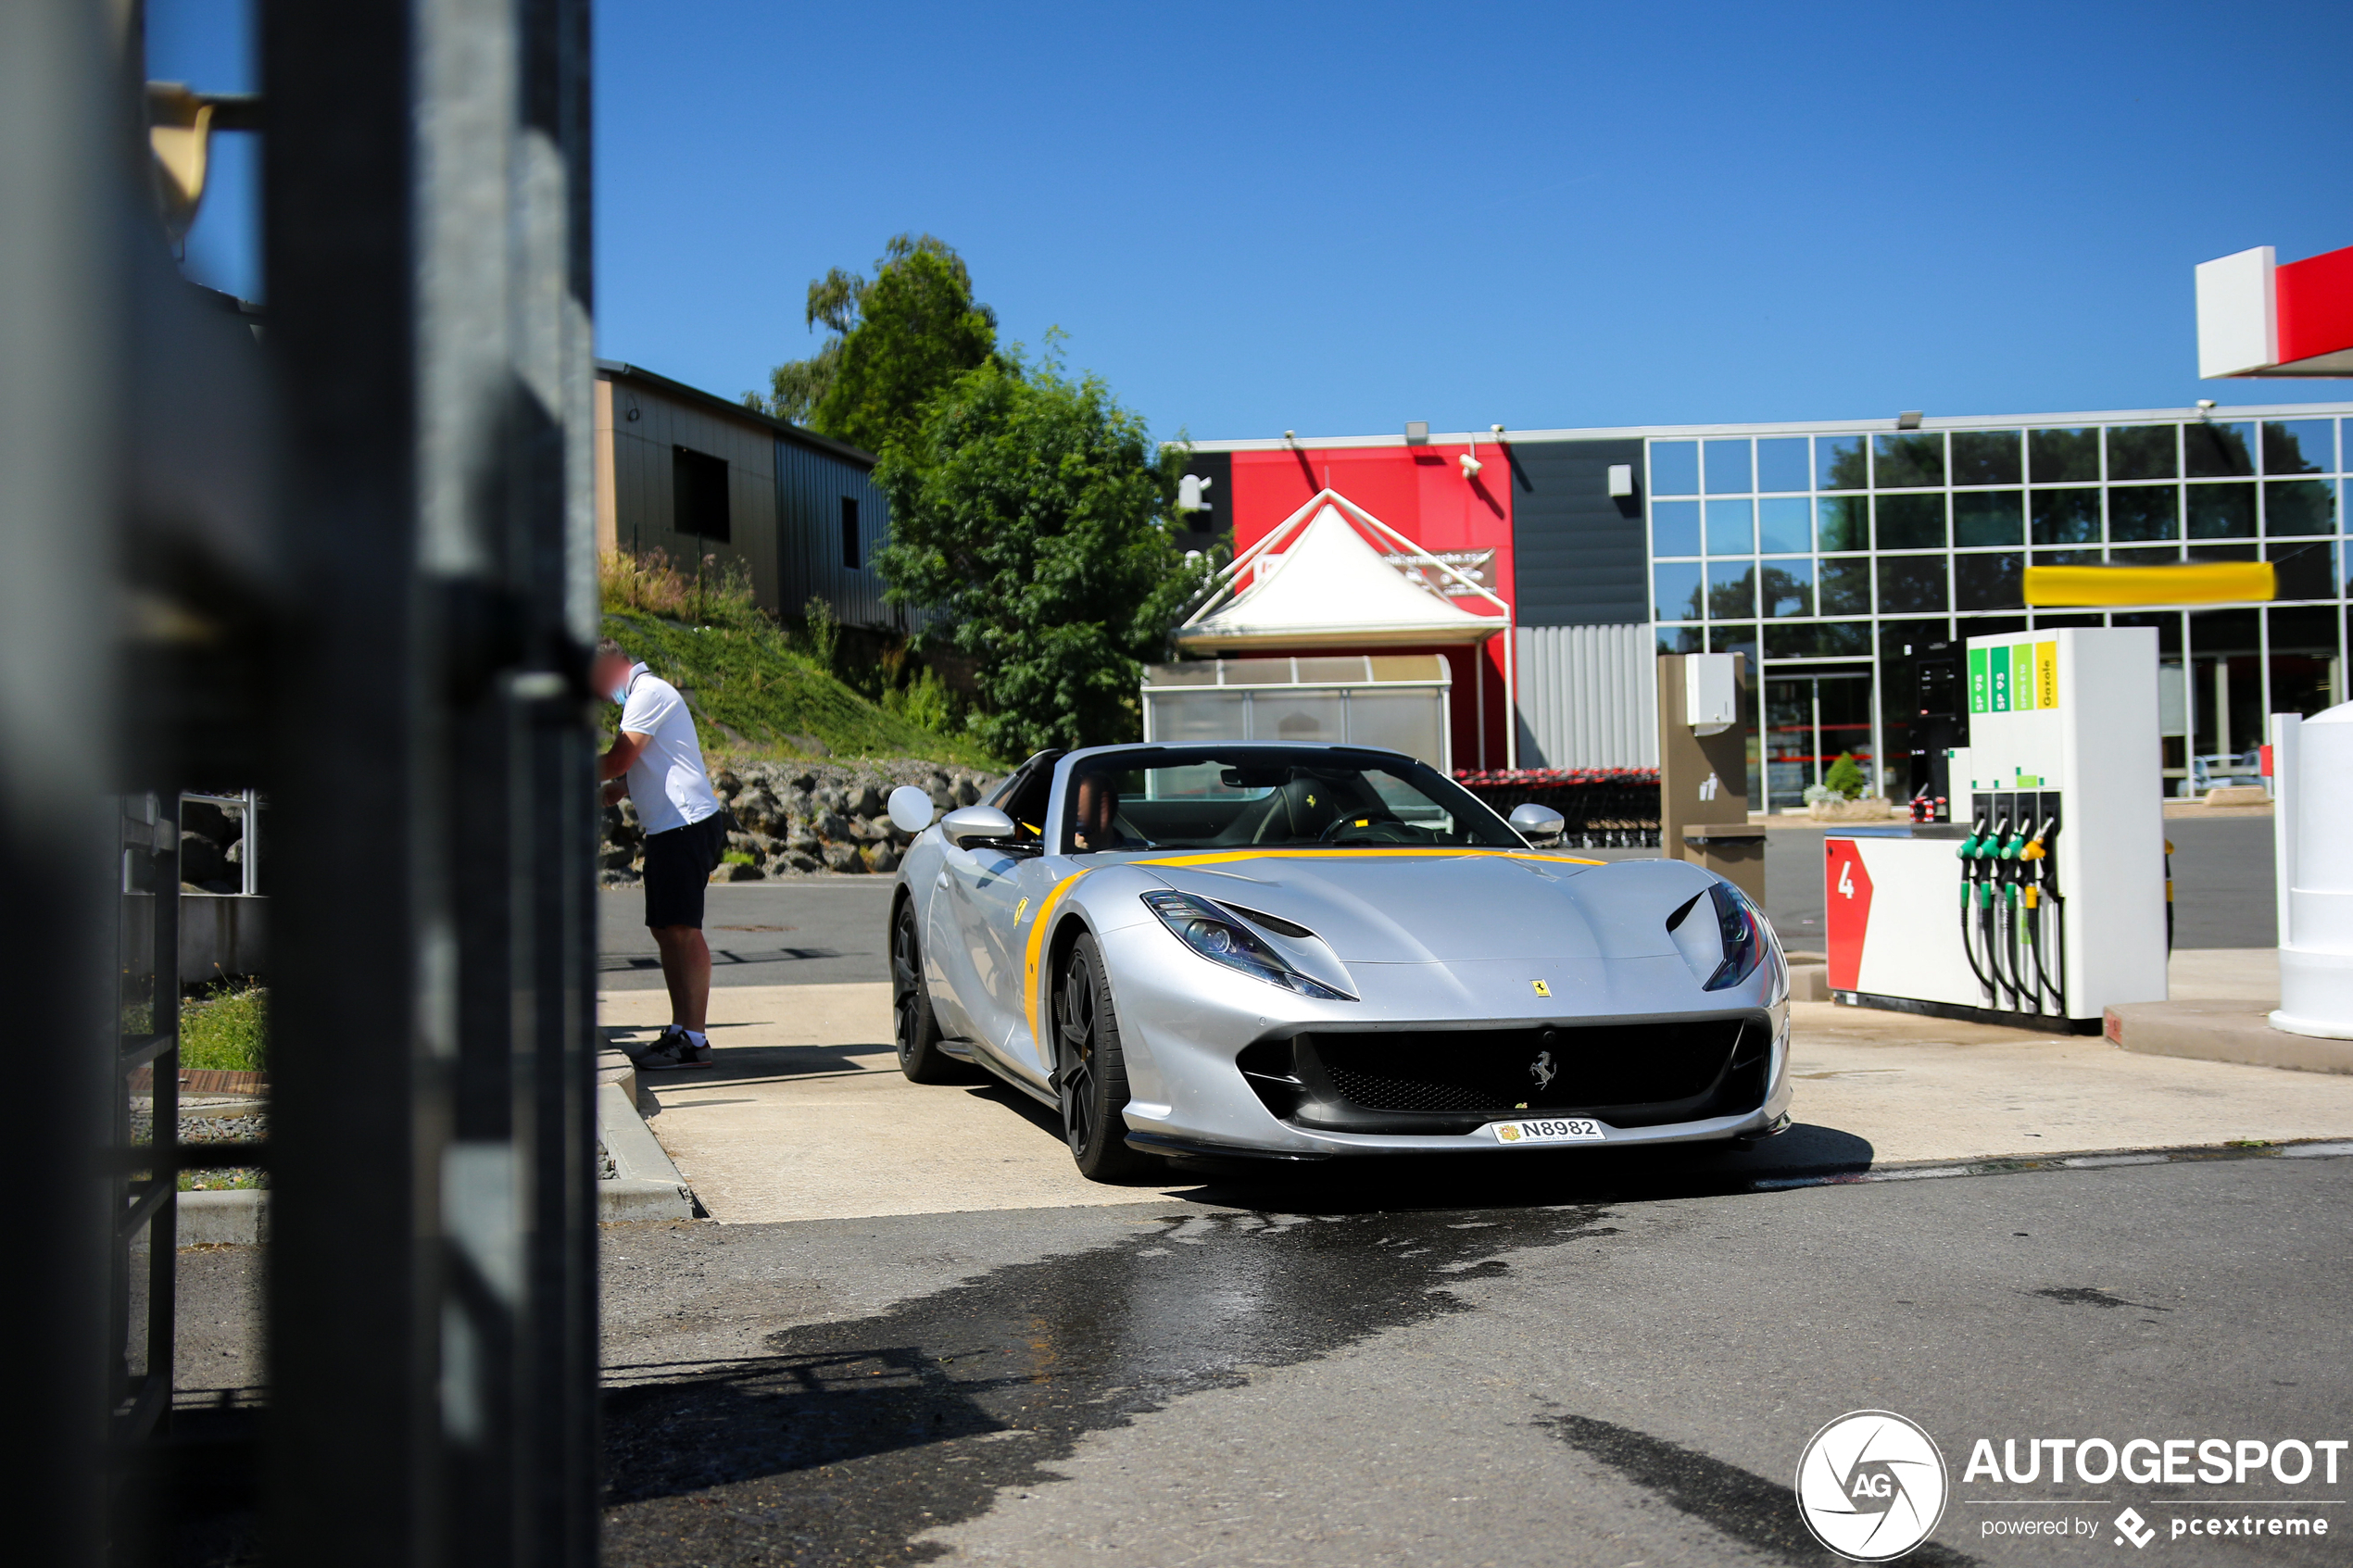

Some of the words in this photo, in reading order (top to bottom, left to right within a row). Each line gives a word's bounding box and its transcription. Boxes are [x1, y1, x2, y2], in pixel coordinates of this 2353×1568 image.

[1995, 672, 2005, 690] 95
[2043, 659, 2051, 707] Gazole
[1976, 695, 1983, 710] SP
[1996, 693, 2005, 709] SP
[1838, 859, 1855, 899] 4
[1521, 1121, 1597, 1136] N8982
